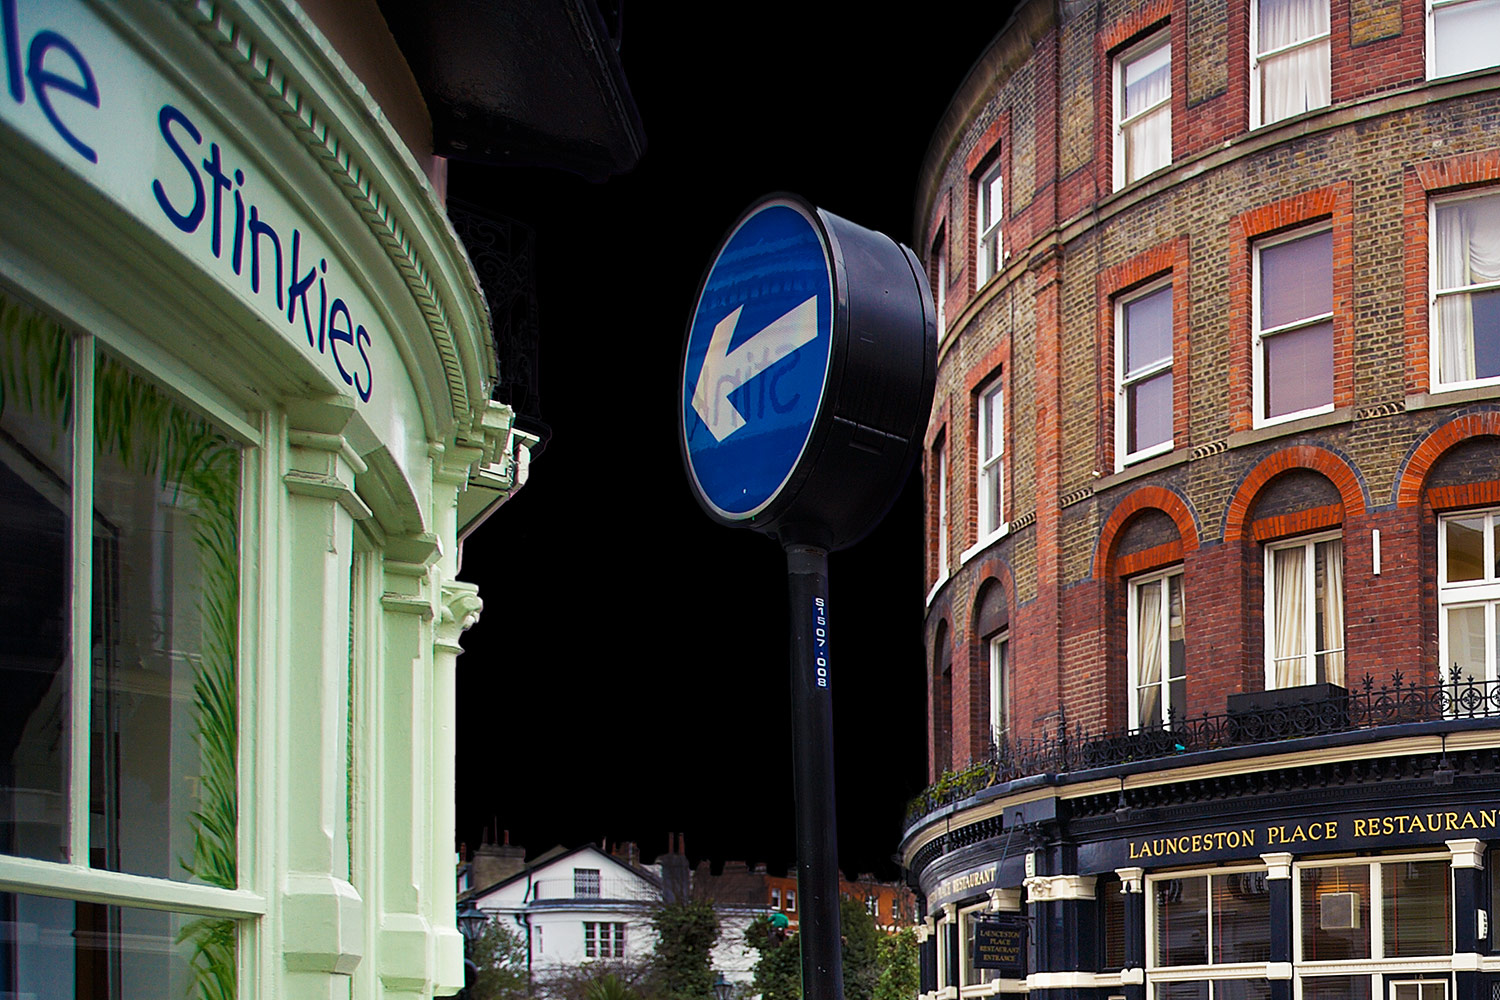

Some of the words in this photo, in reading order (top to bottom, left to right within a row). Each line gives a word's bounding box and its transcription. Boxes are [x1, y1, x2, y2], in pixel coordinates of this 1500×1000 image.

[152, 103, 374, 404] Stinkies
[1129, 829, 1256, 859] LAUNCESTON
[1267, 821, 1338, 845] PLACE
